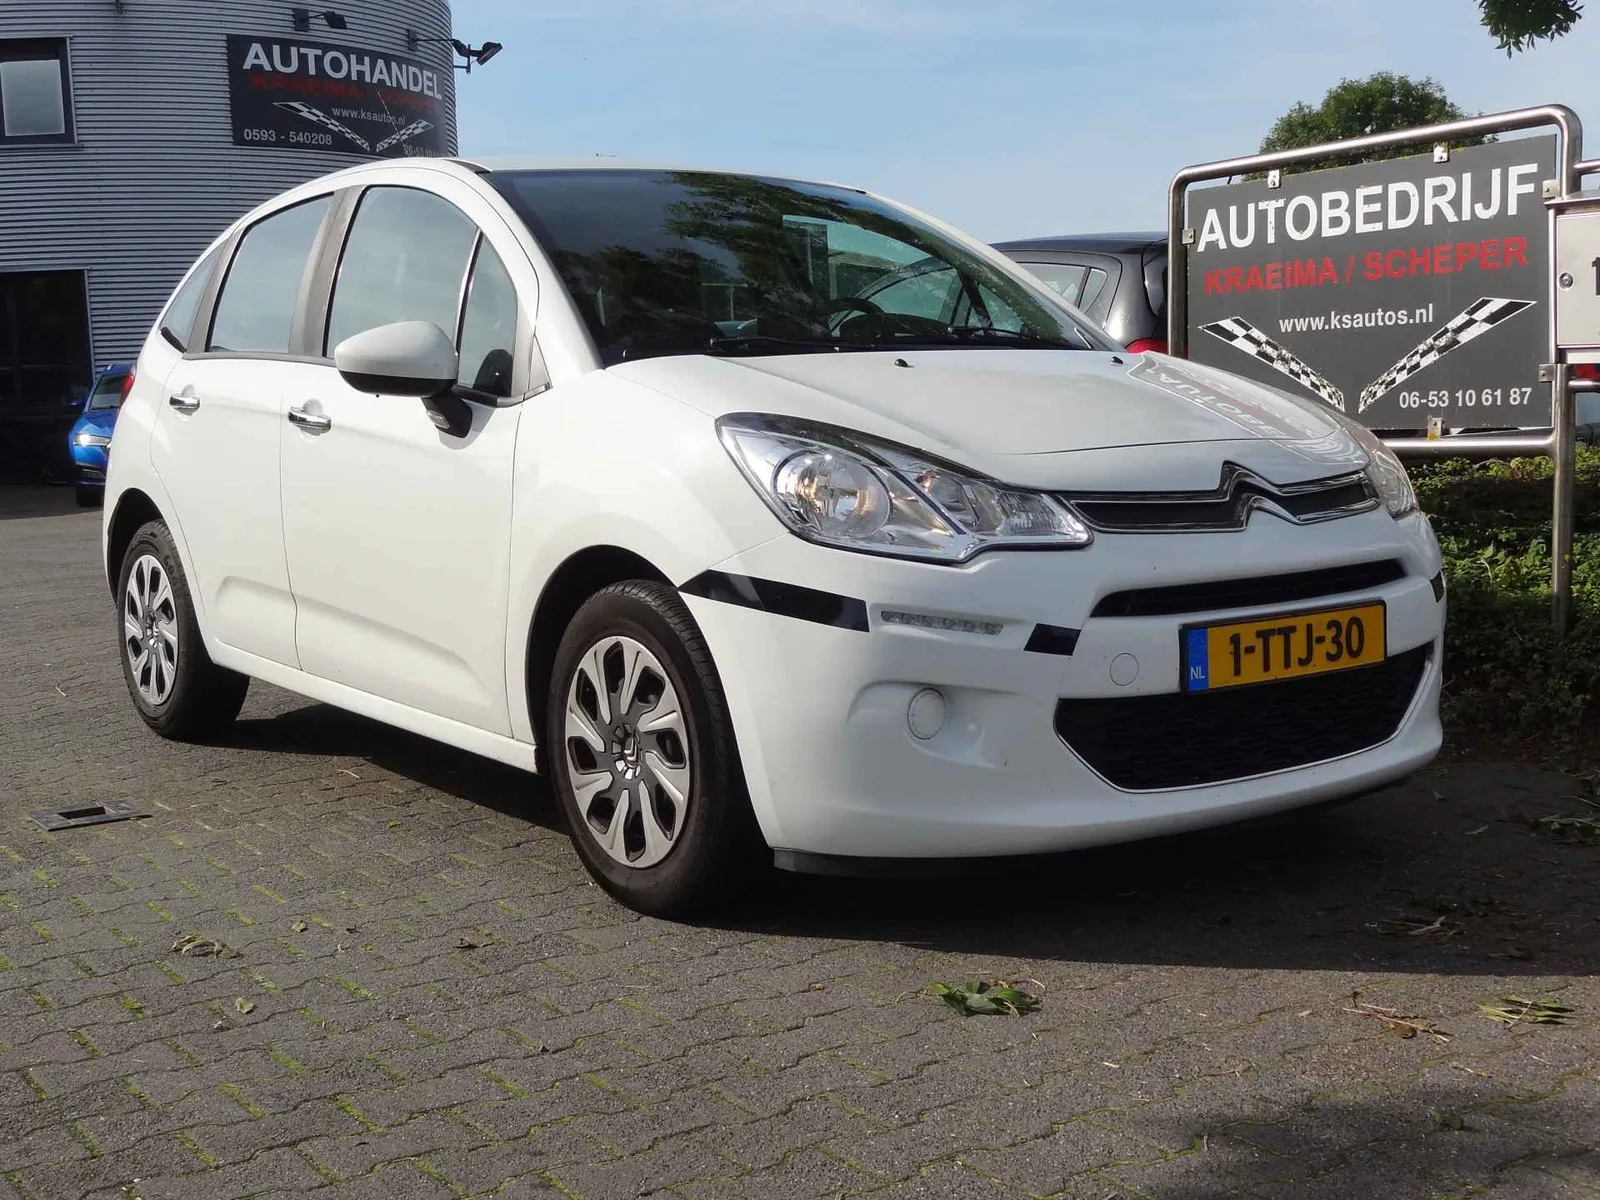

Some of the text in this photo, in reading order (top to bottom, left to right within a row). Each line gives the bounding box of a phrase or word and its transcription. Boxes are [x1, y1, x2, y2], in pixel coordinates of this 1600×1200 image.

[243, 43, 442, 100] AUTOHANDEL
[332, 107, 406, 125] www.ksautos.nl
[244, 129, 276, 141] 0593
[289, 132, 332, 145] 540208
[1197, 163, 1539, 252] AUTOBEDRIJF
[1204, 257, 1337, 295] KRAEIMA
[1363, 236, 1529, 281] SCHEPER
[1279, 303, 1434, 334] www.ksautos.nl
[1399, 387, 1532, 409] 06-53 10 61 87
[1229, 616, 1365, 677] 1-TTJ-30
[1190, 666, 1205, 680] NL
